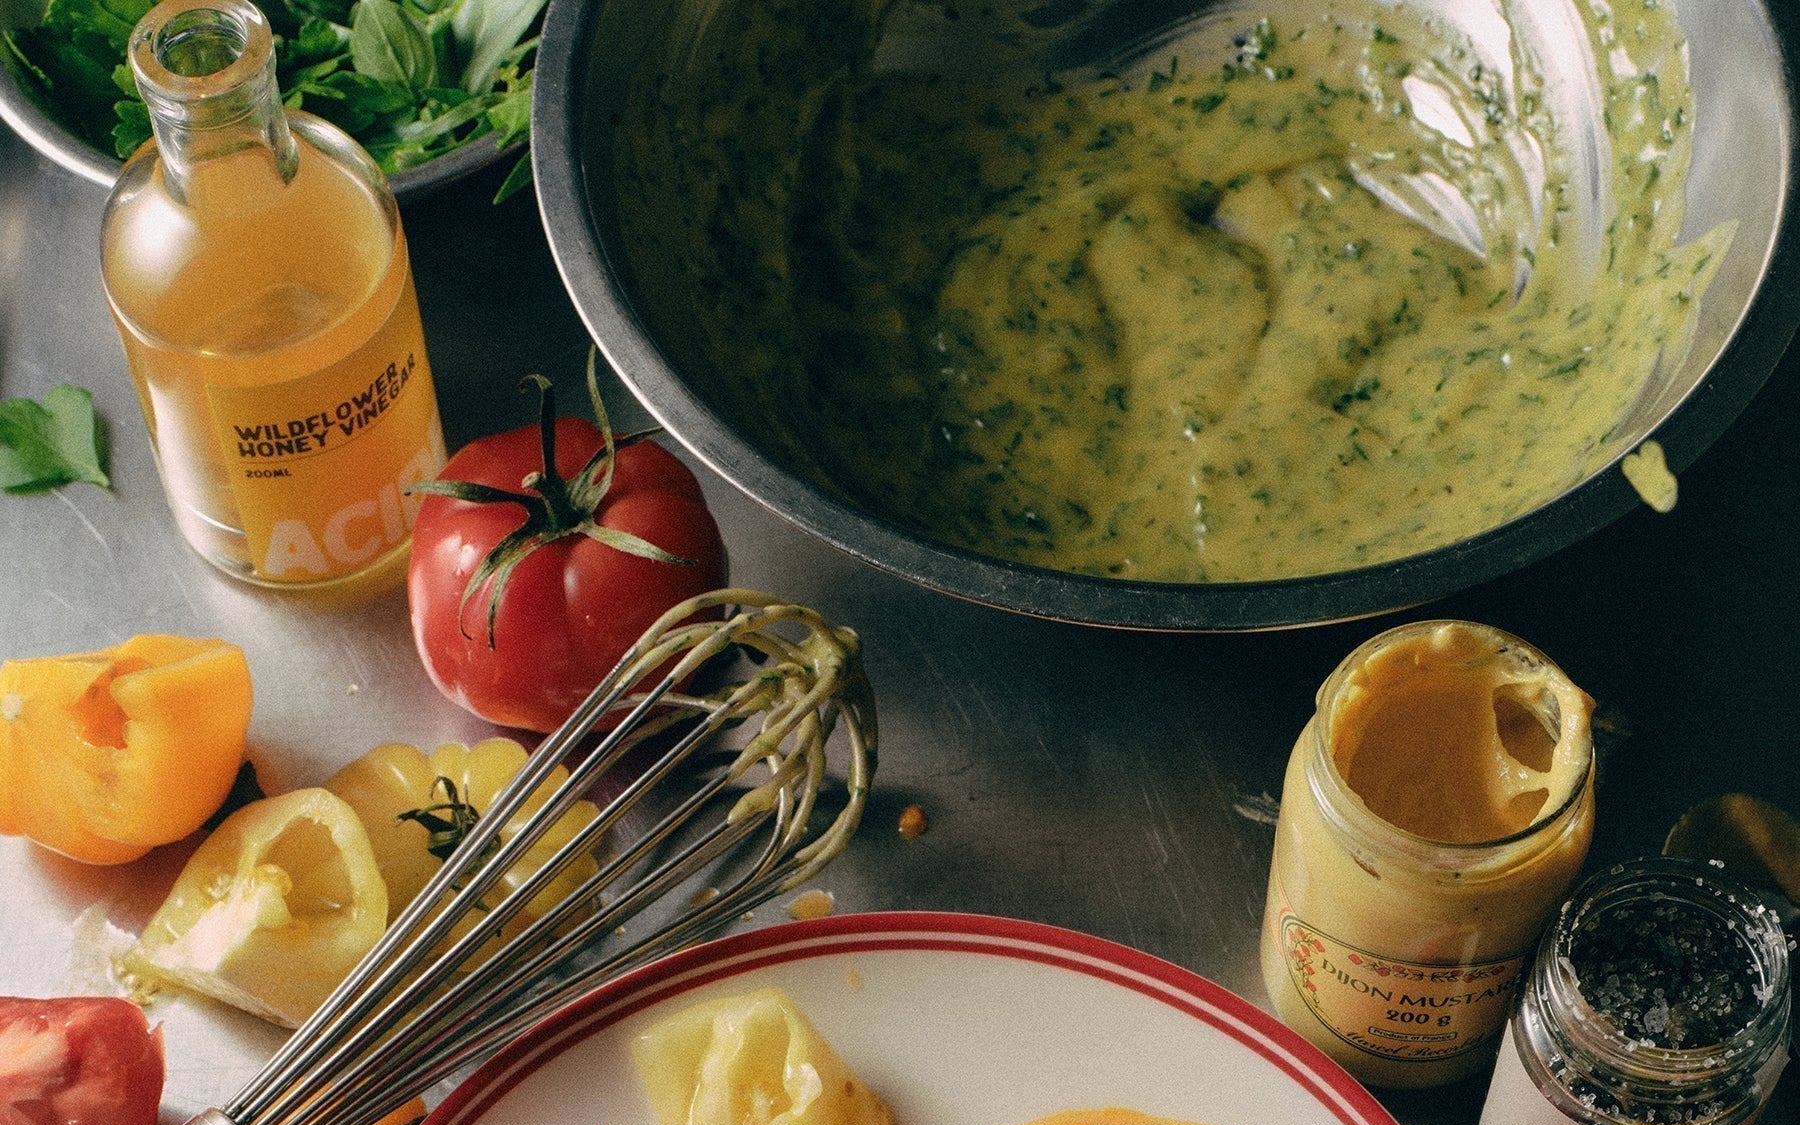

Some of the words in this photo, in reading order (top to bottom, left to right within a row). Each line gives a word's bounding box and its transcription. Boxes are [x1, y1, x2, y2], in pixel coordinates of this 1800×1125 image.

[233, 362, 399, 442] WILDFLOWER
[237, 429, 329, 458] HONEY
[339, 353, 415, 436] VINEGAR
[245, 468, 292, 479] 200ML
[1322, 958, 1392, 1002] DIJON
[1386, 1009, 1430, 1025] 200
